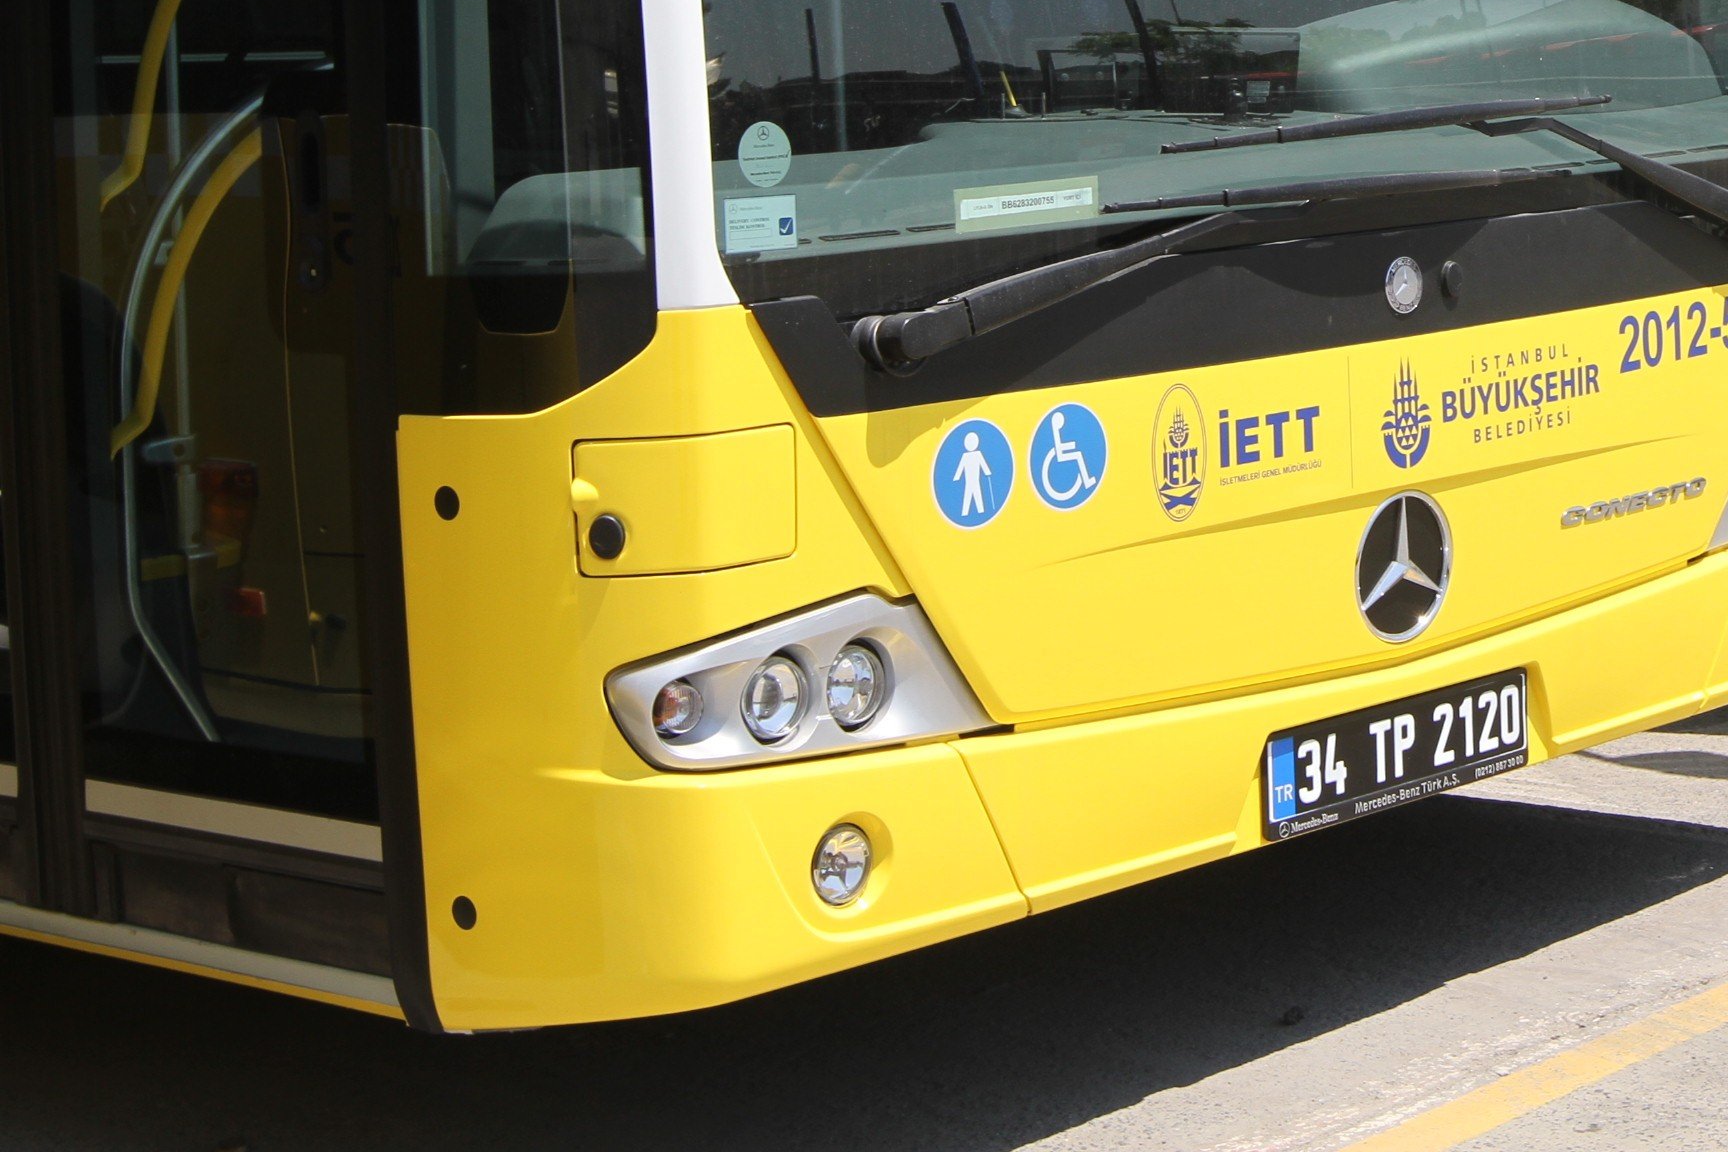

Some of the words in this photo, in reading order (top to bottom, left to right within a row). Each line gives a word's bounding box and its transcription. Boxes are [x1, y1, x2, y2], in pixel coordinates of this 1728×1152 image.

[1471, 343, 1568, 374] İSTANBUL
[1441, 356, 1600, 424] BÜYÜKŞEHİR
[1219, 405, 1320, 468] İETT
[1473, 405, 1571, 444] BELEDİYESİ
[1261, 468, 1281, 478] GENEL
[1560, 477, 1707, 529] CONECTO
[1297, 733, 1347, 804] 34
[1368, 713, 1416, 784] TP
[1432, 684, 1521, 767] 2120
[1474, 764, 1495, 779] (0212)
[1274, 784, 1294, 803] TR
[1354, 786, 1421, 814] Mercedes-Benz
[1421, 779, 1442, 794] Türk
[1290, 813, 1339, 833] Mercedes-Benz
